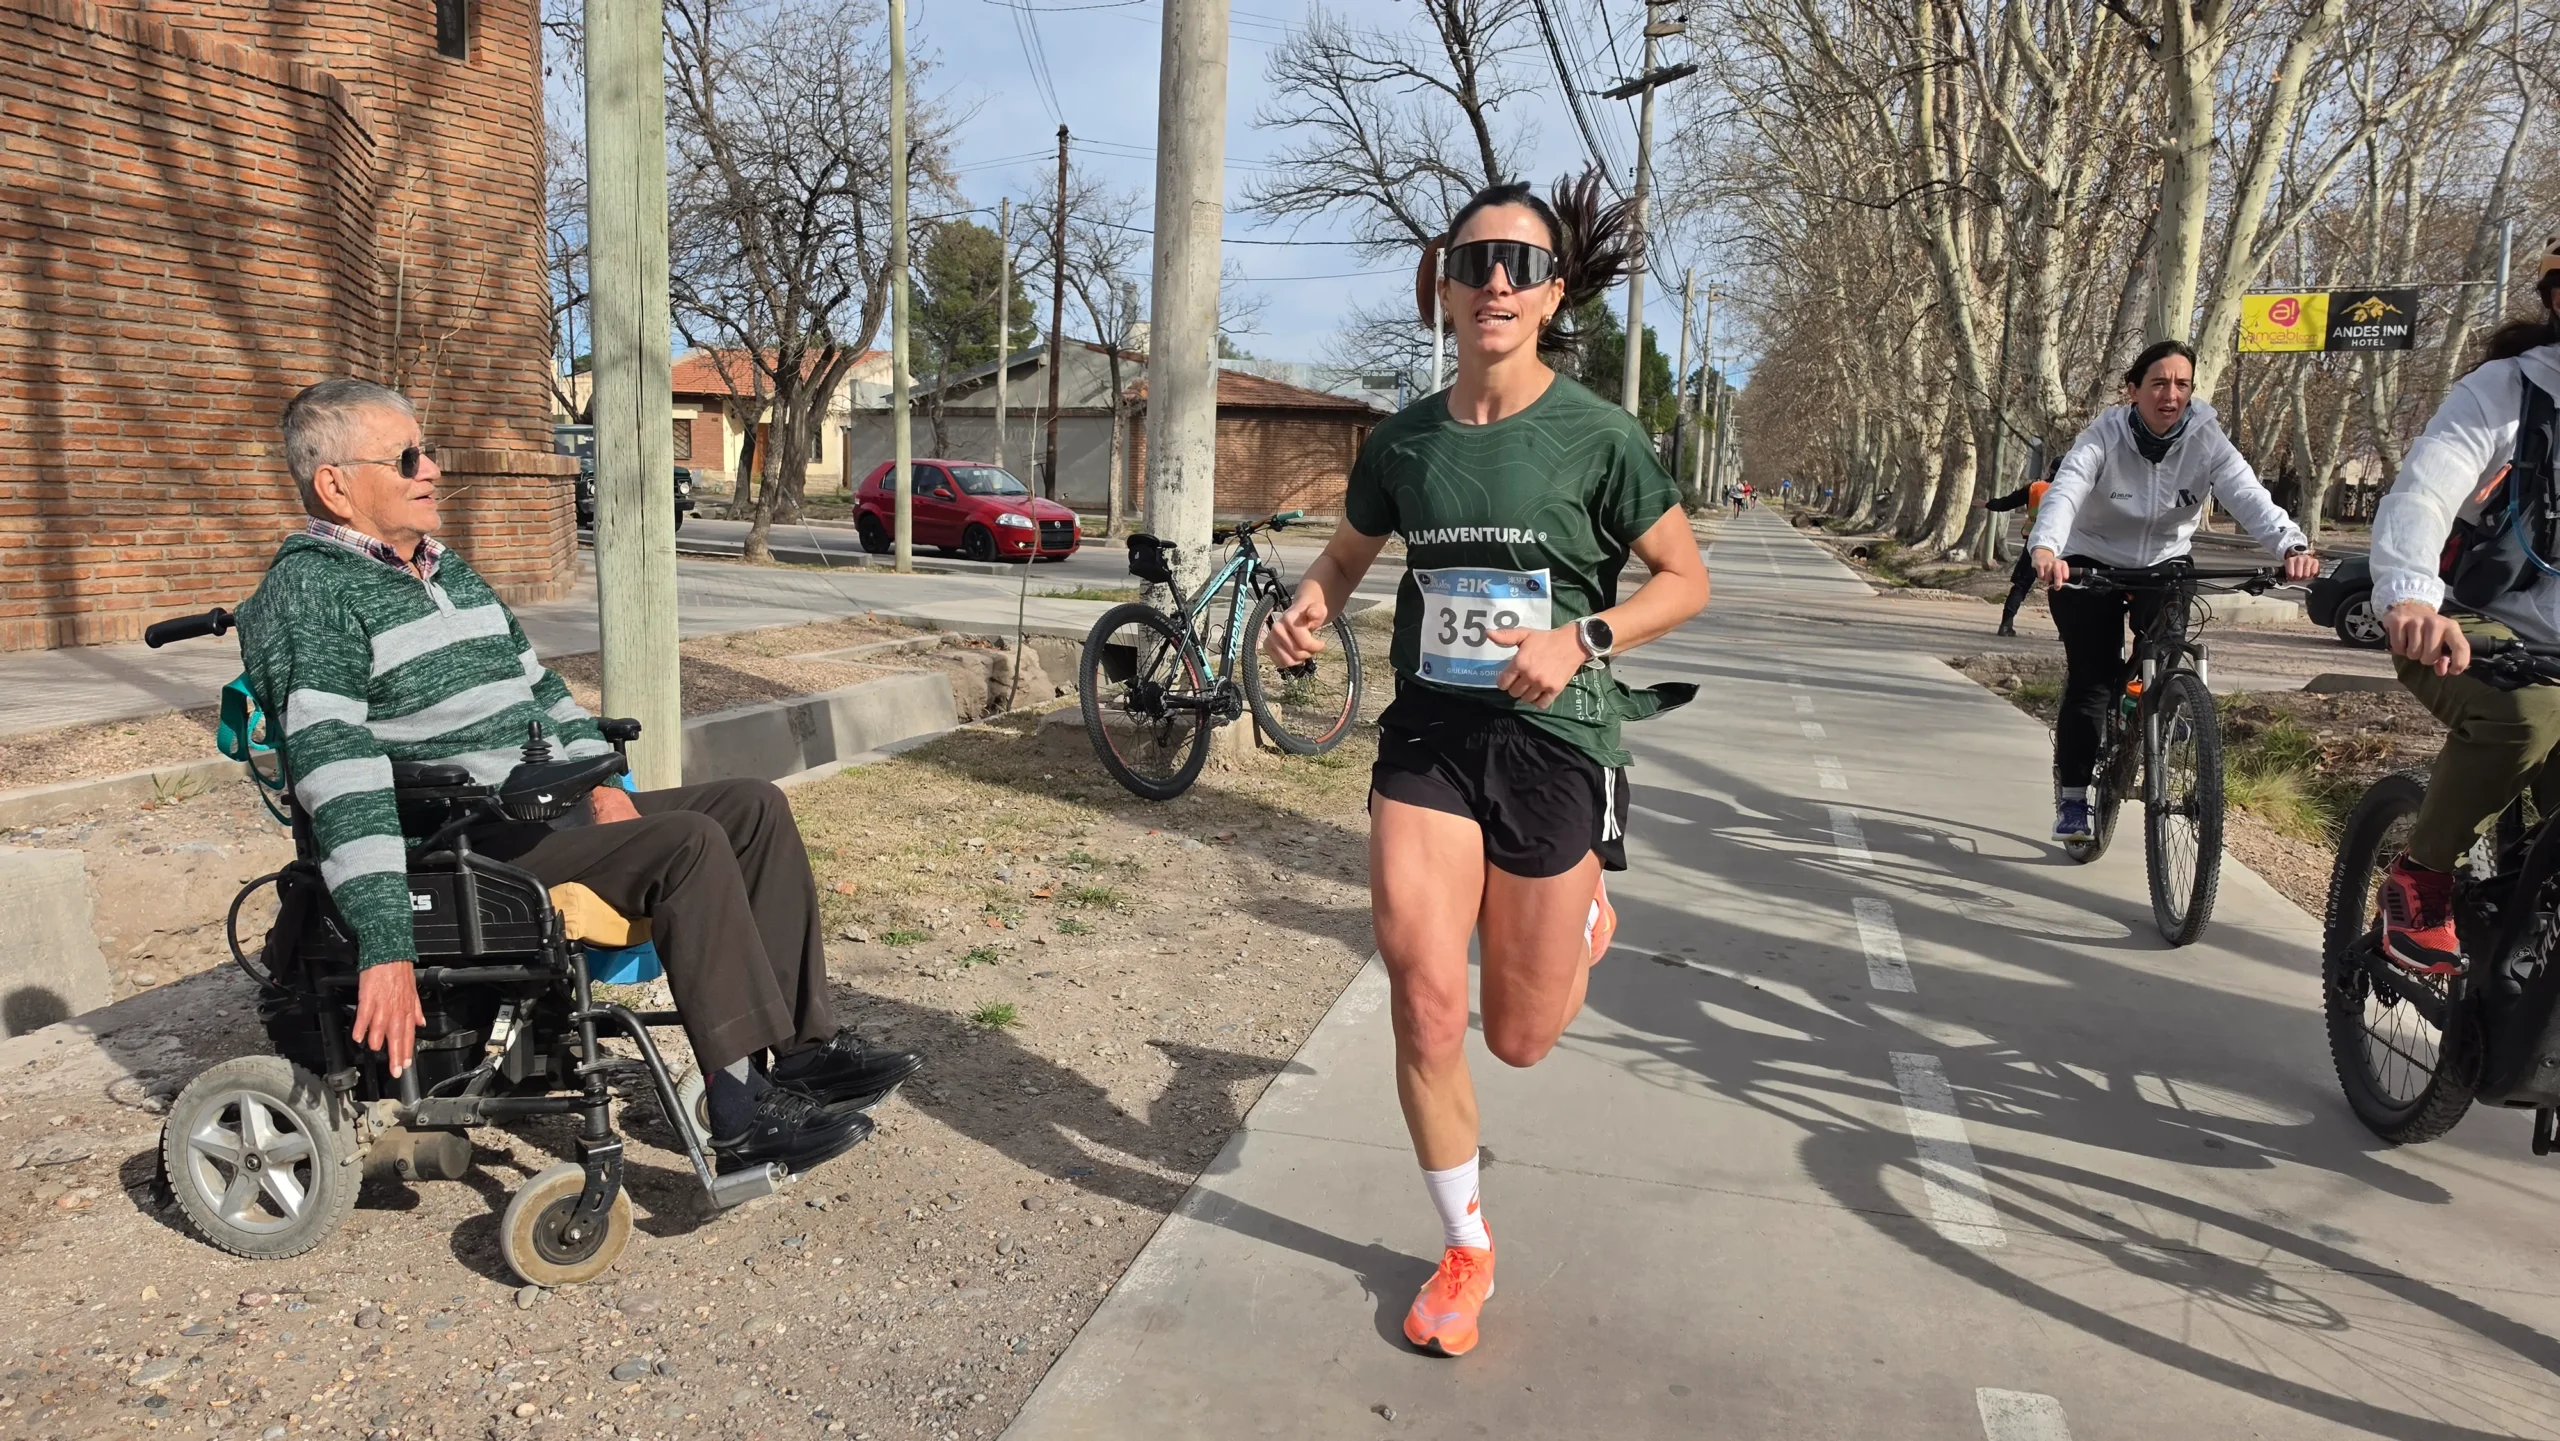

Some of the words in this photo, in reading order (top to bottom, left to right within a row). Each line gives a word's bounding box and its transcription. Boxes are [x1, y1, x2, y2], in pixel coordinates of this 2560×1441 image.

[2332, 325, 2380, 338] ANDES
[2383, 324, 2408, 337] INN
[2351, 338, 2386, 347] HOTEL
[1456, 577, 1492, 594] 21K
[2329, 862, 2347, 928] ELIMINATOR
